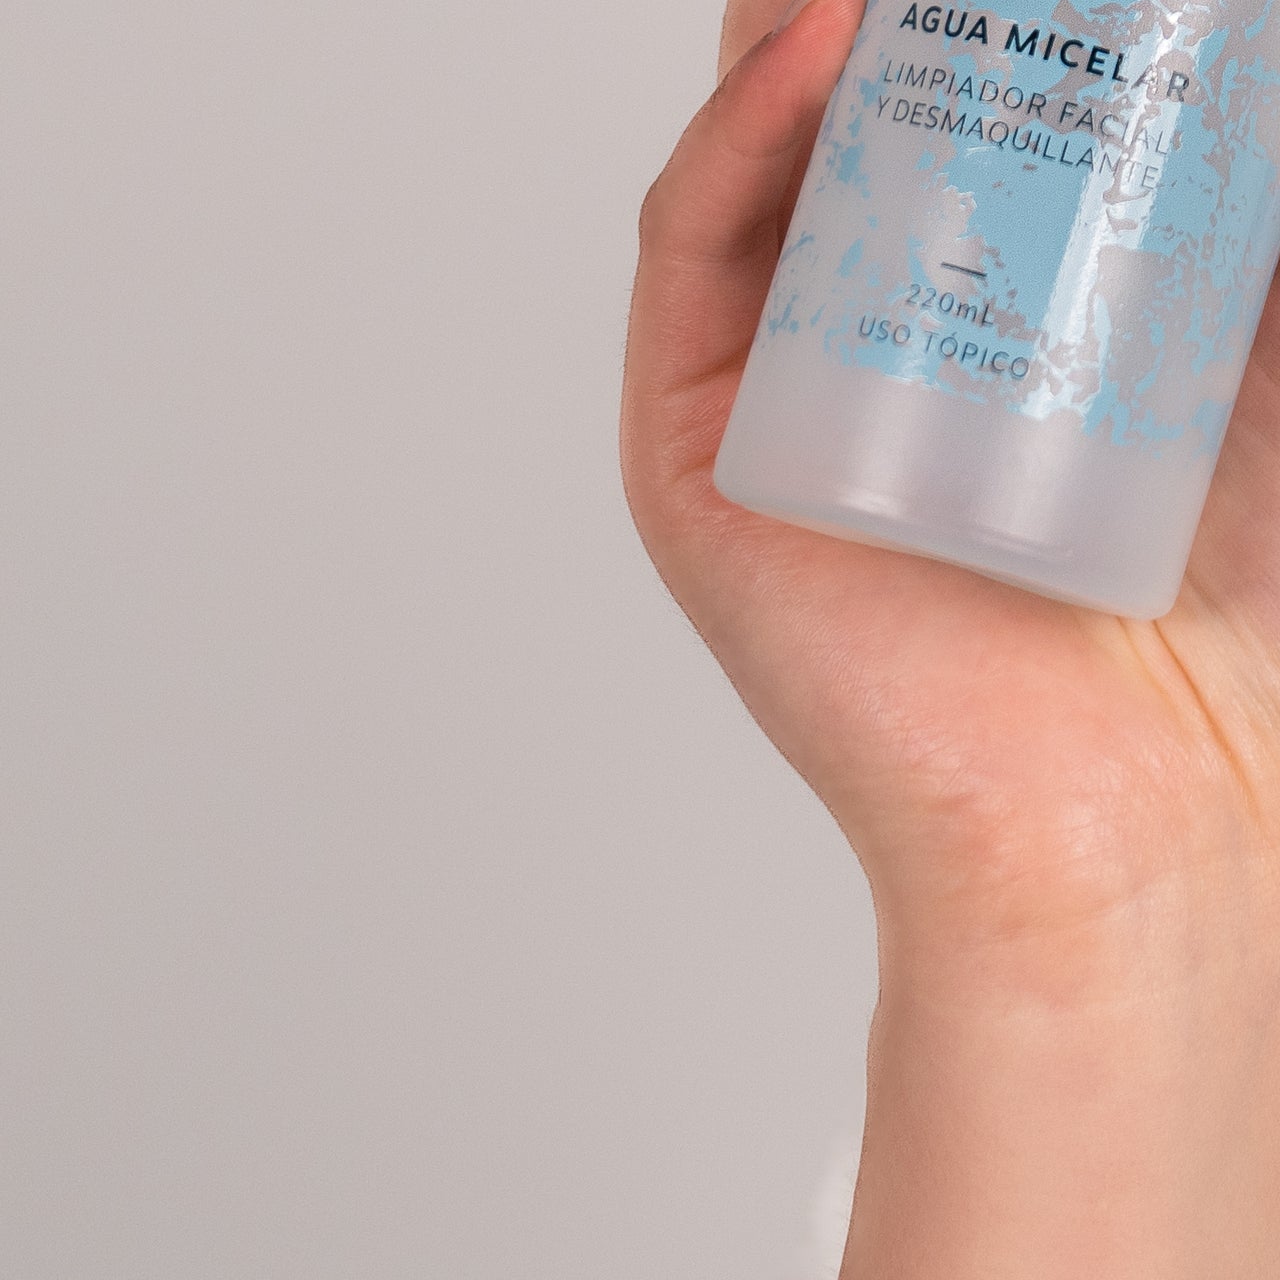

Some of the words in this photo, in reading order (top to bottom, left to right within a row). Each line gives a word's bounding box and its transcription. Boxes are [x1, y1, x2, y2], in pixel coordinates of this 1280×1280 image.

[900, 2, 989, 44] AGUA
[1004, 23, 1190, 102] MICELAR
[876, 95, 890, 119] Y
[892, 97, 1160, 191] DESMAQUILLANTE
[883, 59, 1047, 118] LIMPIADOR
[1059, 101, 1169, 156] FACIAL
[858, 315, 911, 345] USO
[924, 331, 1030, 379] TÓPICO
[905, 283, 994, 327] 220mL
